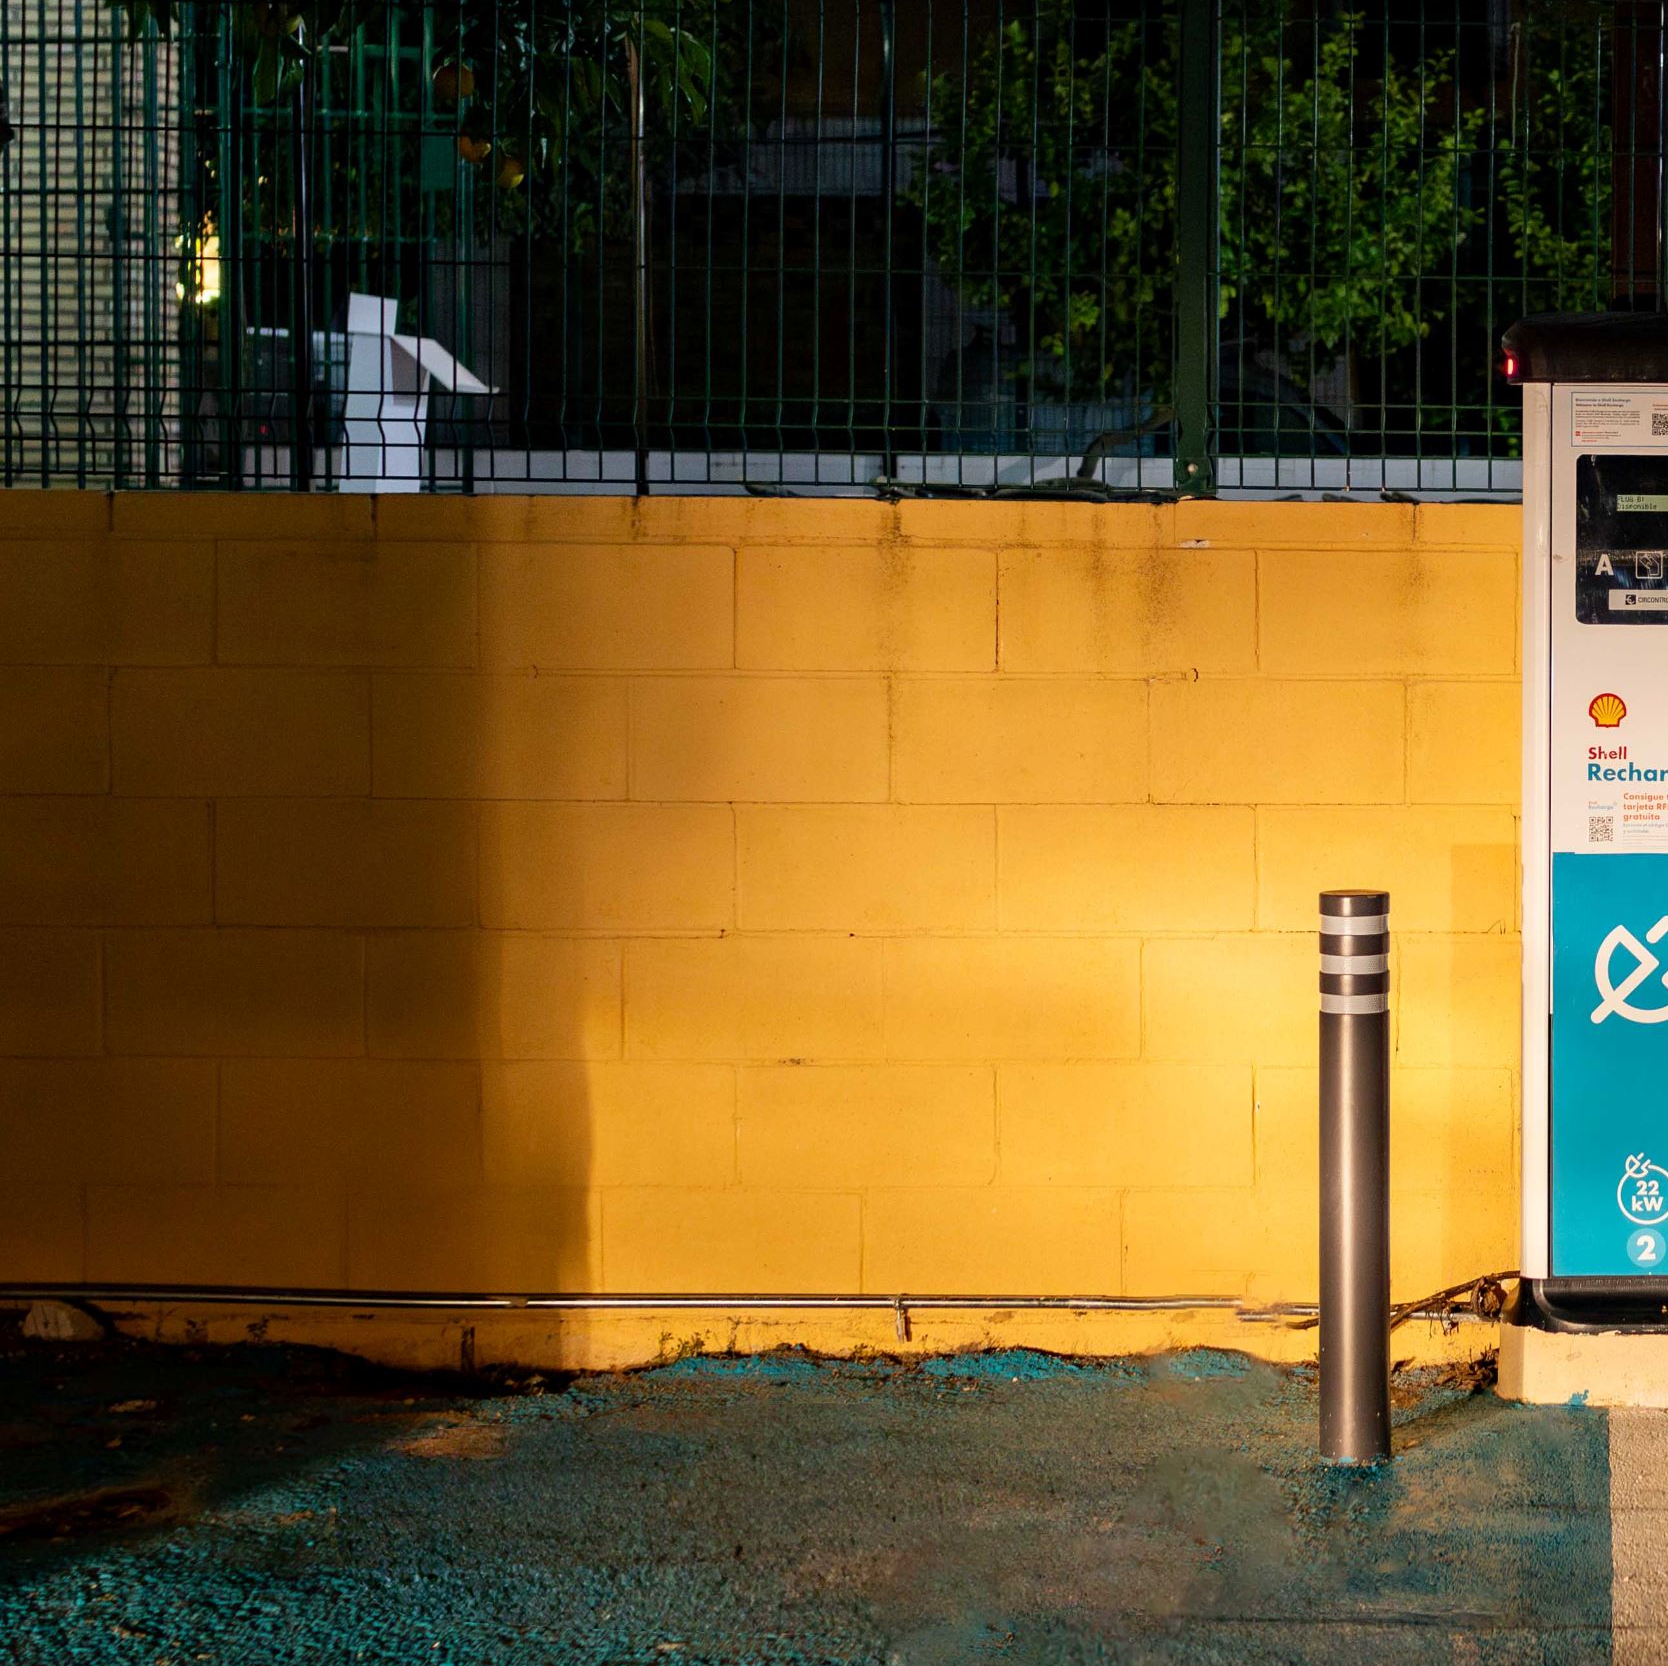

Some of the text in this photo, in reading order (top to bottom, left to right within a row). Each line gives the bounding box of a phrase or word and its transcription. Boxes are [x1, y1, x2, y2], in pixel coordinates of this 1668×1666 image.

[1595, 553, 1614, 575] A
[1588, 745, 1627, 760] Shell
[1623, 792, 1664, 802] Consigue
[1623, 802, 1654, 812] tarjeta
[1623, 812, 1660, 822] gratuita
[1636, 1180, 1660, 1196] 22
[1631, 1195, 1664, 1212] kW
[1636, 1234, 1657, 1261] 2
